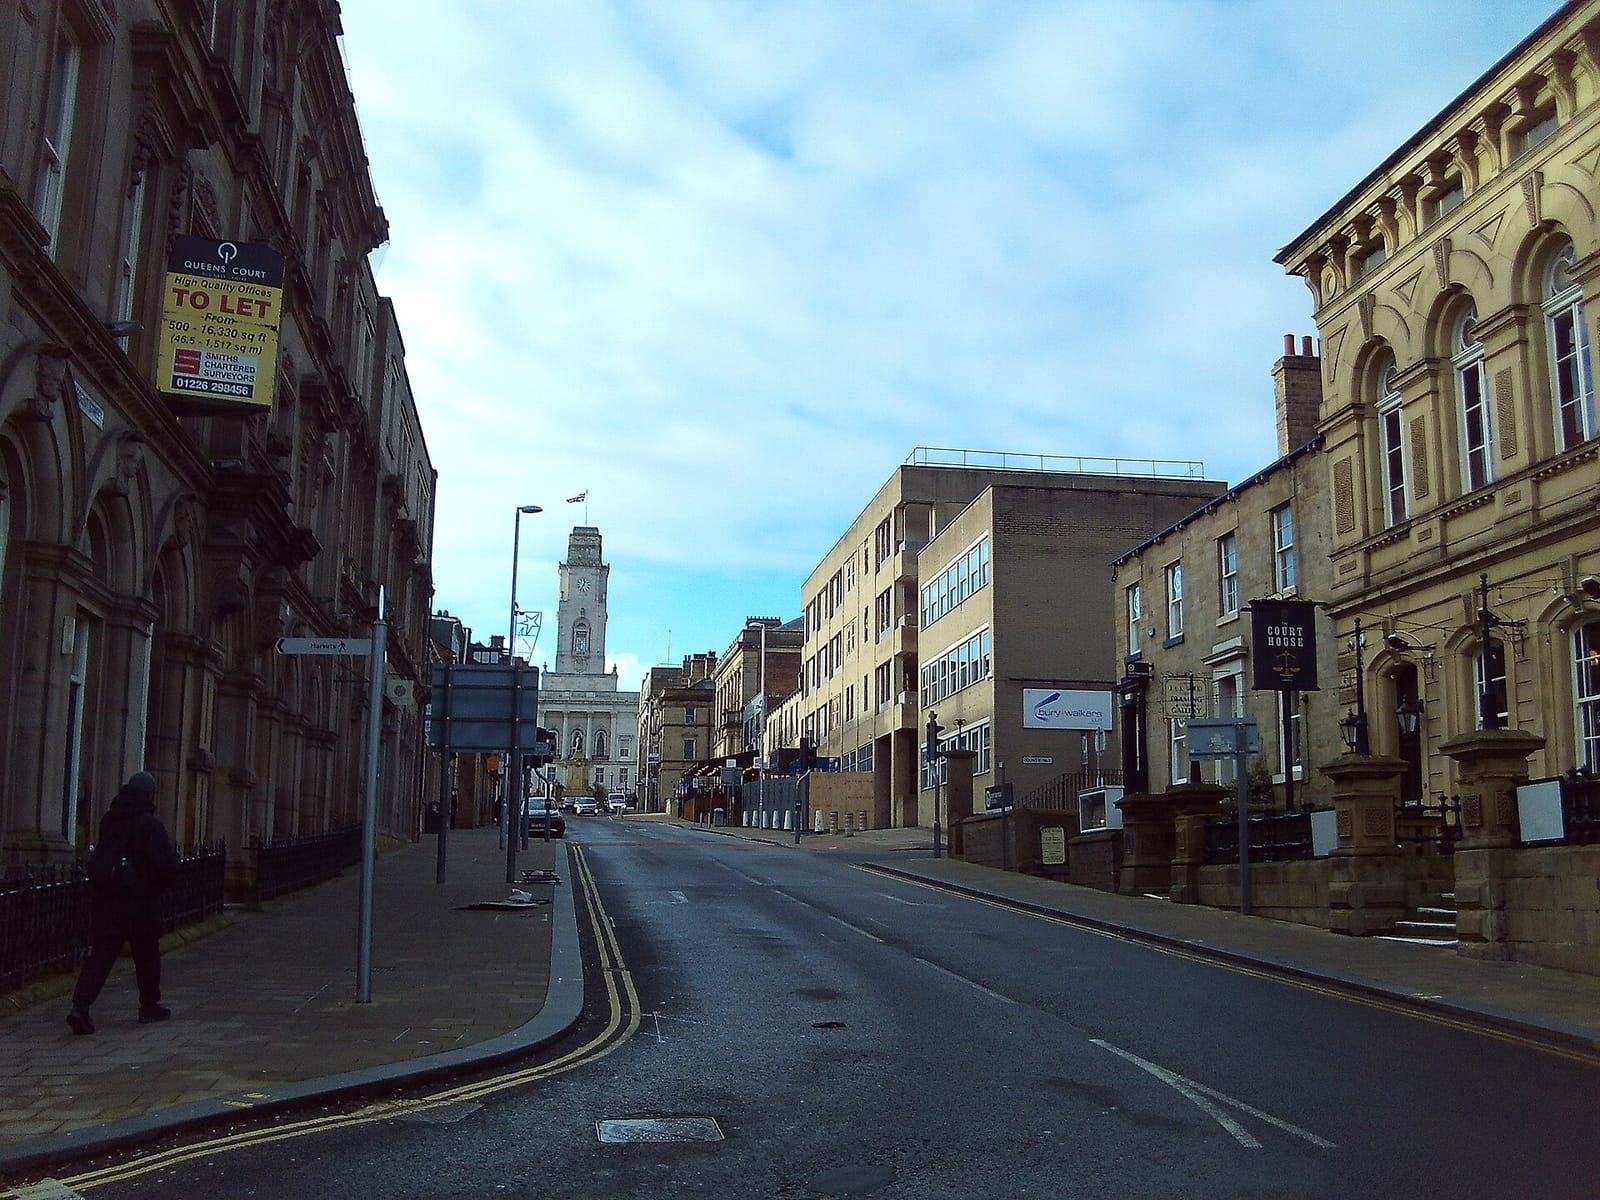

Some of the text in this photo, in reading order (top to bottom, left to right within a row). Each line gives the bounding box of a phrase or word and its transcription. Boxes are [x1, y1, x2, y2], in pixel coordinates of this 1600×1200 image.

[184, 260, 226, 273] QUEENS
[232, 267, 266, 279] COURT
[174, 276, 198, 287] High
[200, 279, 235, 293] Quality
[238, 285, 272, 298] Offices
[172, 287, 272, 319] TO LET
[204, 312, 236, 325] From
[168, 320, 190, 332] 500
[201, 325, 238, 338] 16,330
[240, 332, 255, 342] sq
[258, 332, 267, 342] ft
[170, 334, 196, 345] (46.5
[205, 338, 232, 350] 1,517
[233, 343, 247, 354] sq
[248, 345, 263, 355] m)
[205, 352, 239, 363] SMITHS
[204, 360, 256, 374] CHARTERED
[203, 369, 255, 382] SURVEYORS
[176, 378, 249, 395] 01226 298456
[1267, 625, 1303, 636] COURT
[1268, 636, 1304, 647] HOUSE
